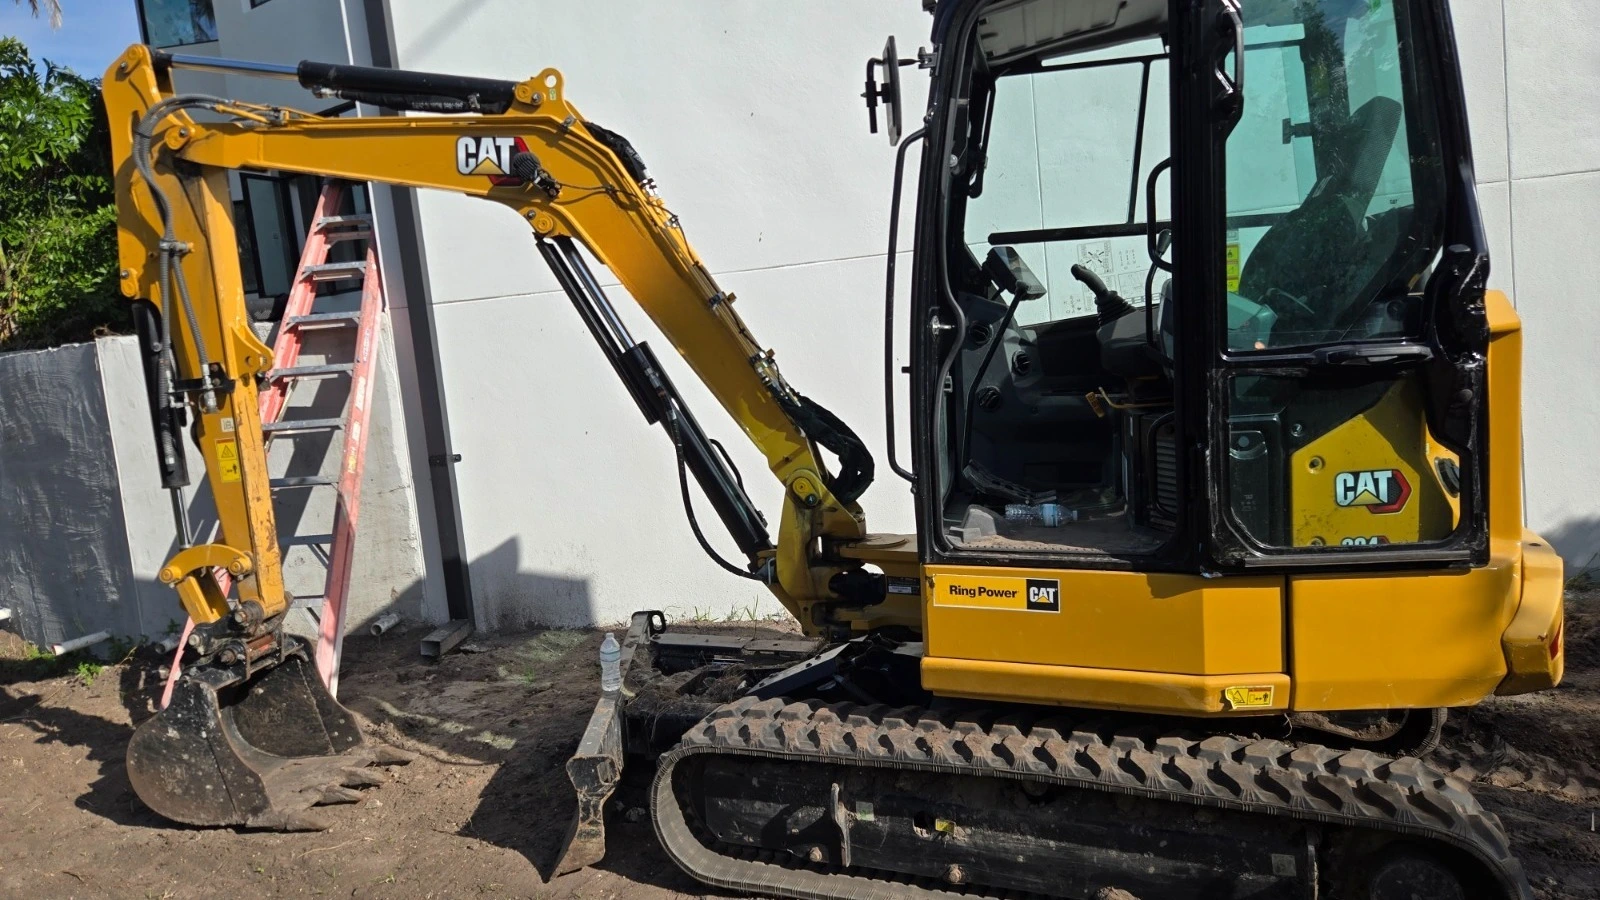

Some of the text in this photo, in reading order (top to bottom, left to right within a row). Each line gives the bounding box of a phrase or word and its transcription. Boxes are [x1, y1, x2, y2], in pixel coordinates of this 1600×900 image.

[457, 136, 515, 175] CAT
[1335, 470, 1393, 506] CAT
[949, 585, 1018, 598] Ring Power
[1029, 586, 1056, 604] CAT
